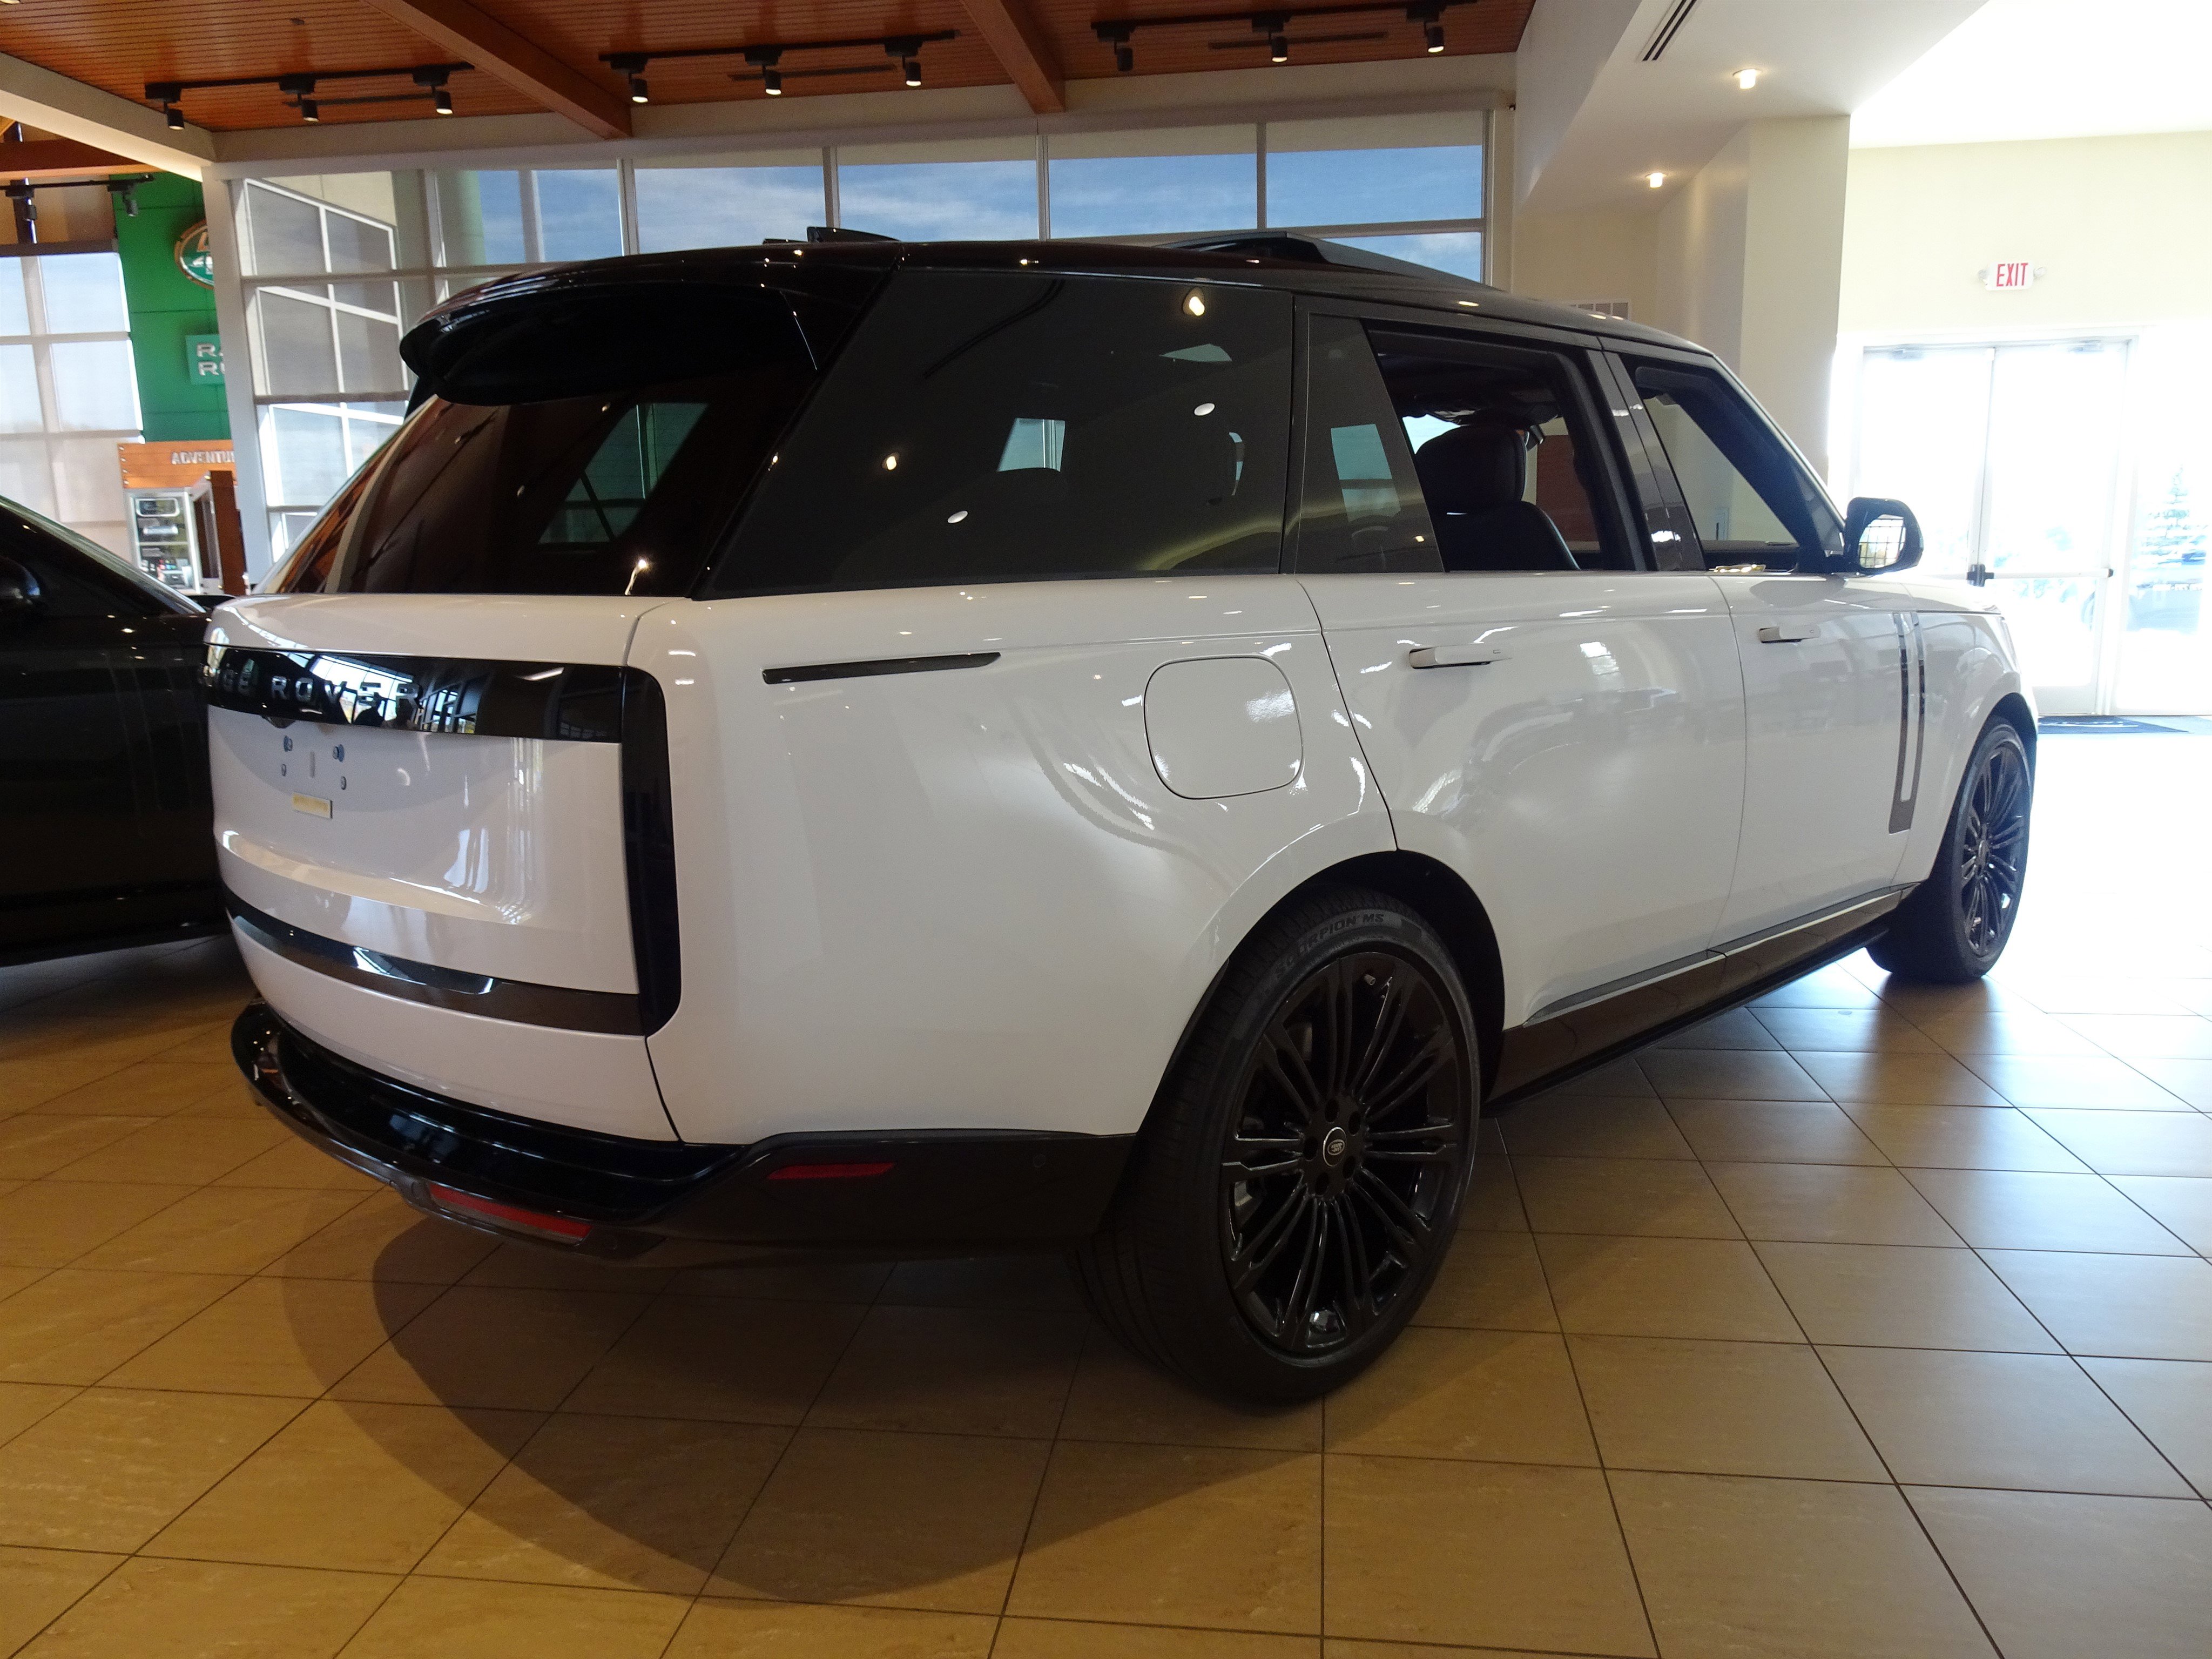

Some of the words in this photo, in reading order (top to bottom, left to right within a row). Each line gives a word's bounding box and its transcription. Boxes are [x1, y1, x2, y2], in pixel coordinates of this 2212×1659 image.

[1996, 262, 2028, 287] EXIT
[271, 675, 424, 709] ROVER
[1362, 913, 1384, 923] MS
